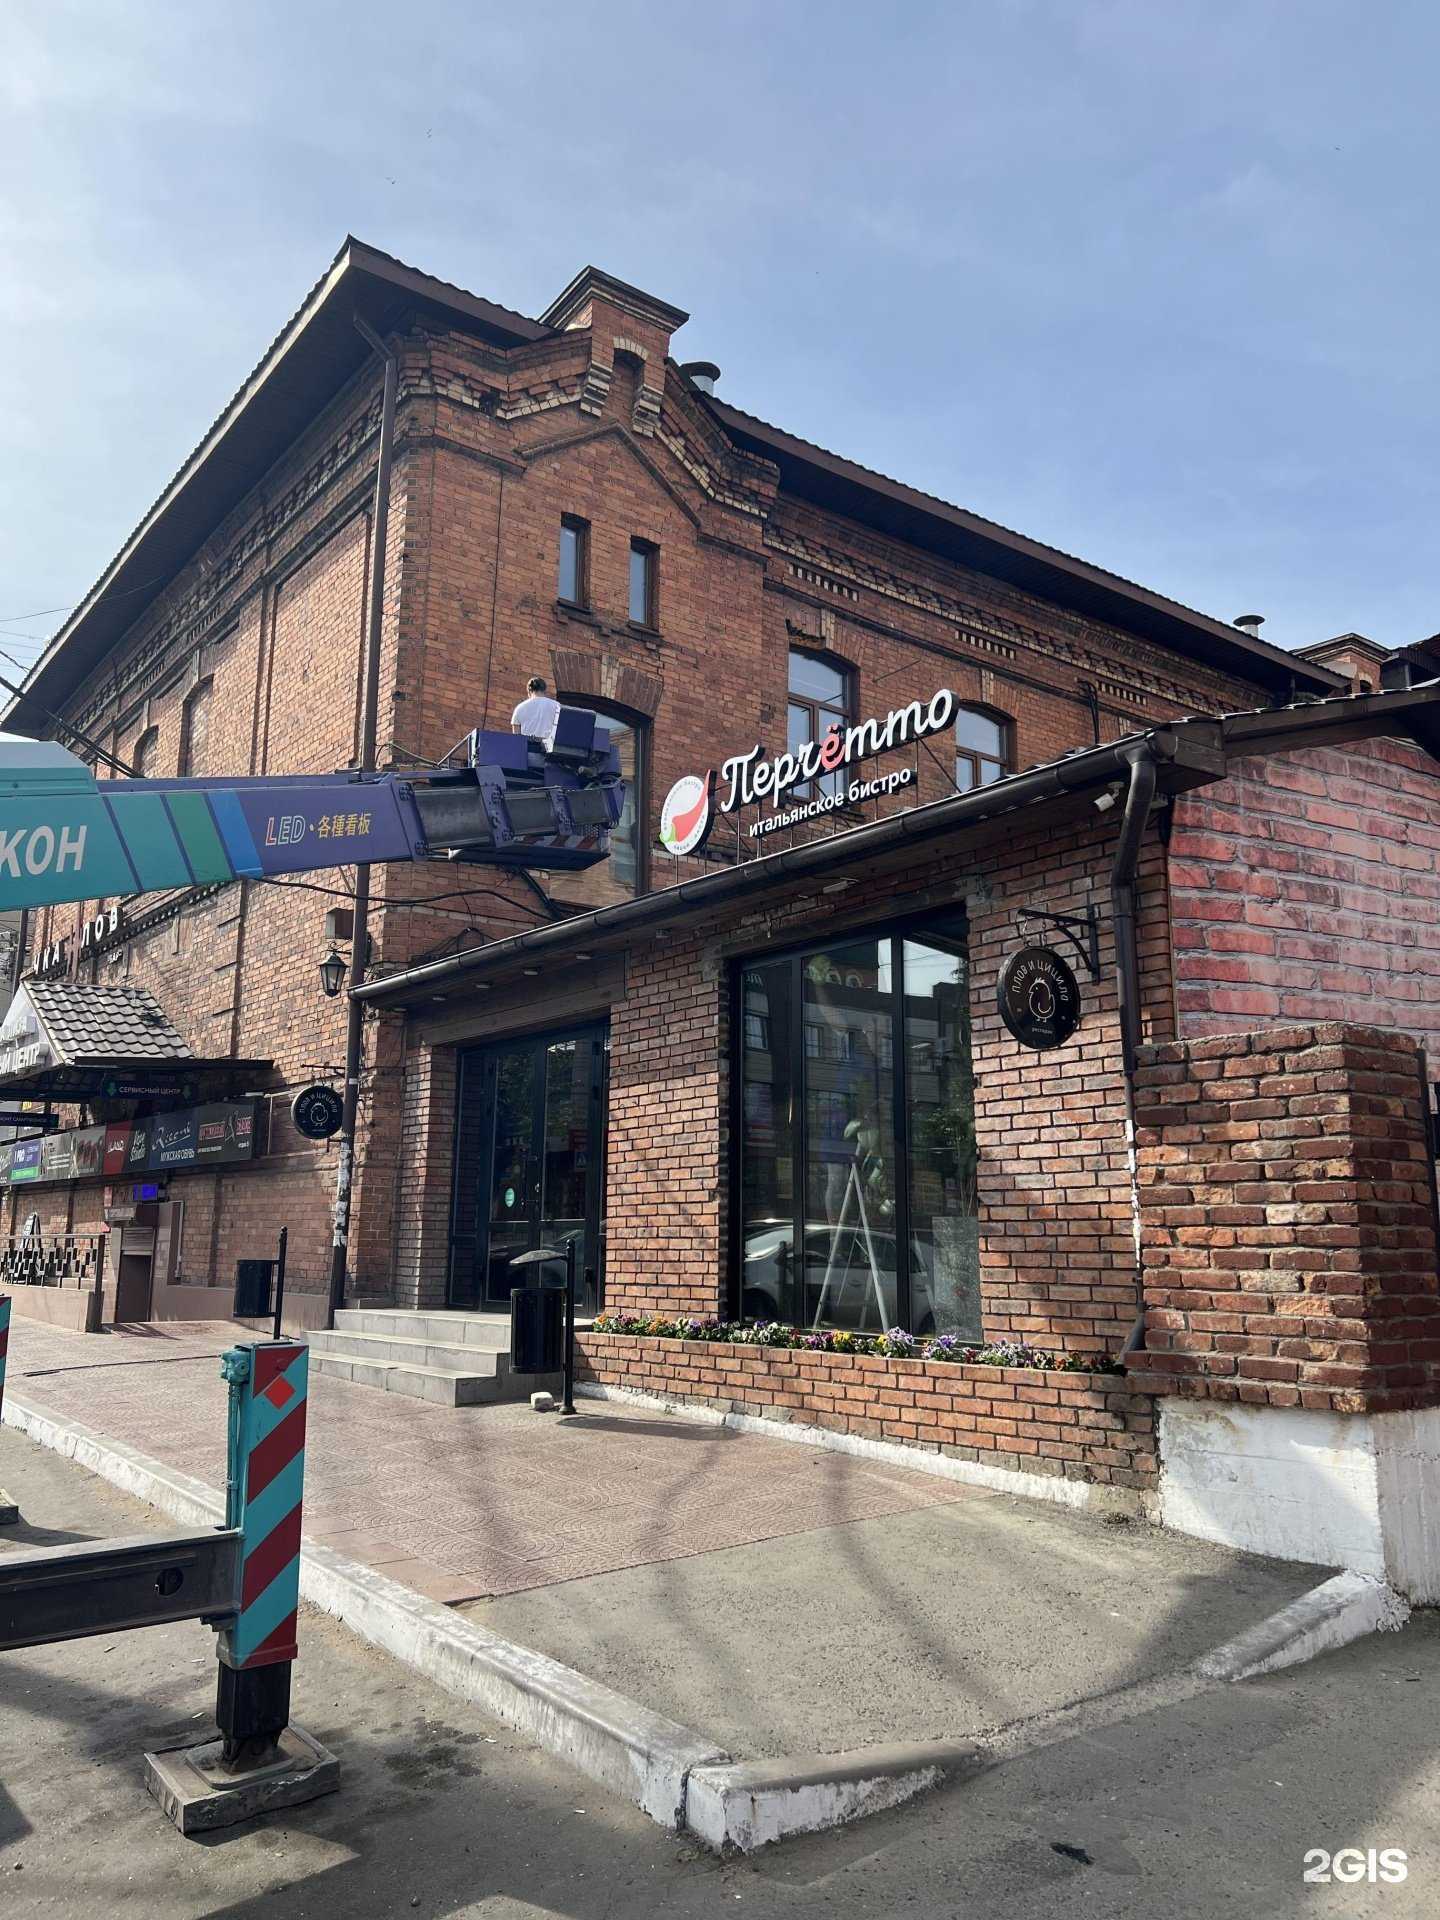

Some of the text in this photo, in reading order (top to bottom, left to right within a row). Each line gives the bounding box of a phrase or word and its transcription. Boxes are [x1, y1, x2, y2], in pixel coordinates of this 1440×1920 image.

[749, 791, 844, 838] итальянское
[848, 768, 911, 802] бистро
[265, 815, 305, 846] LED
